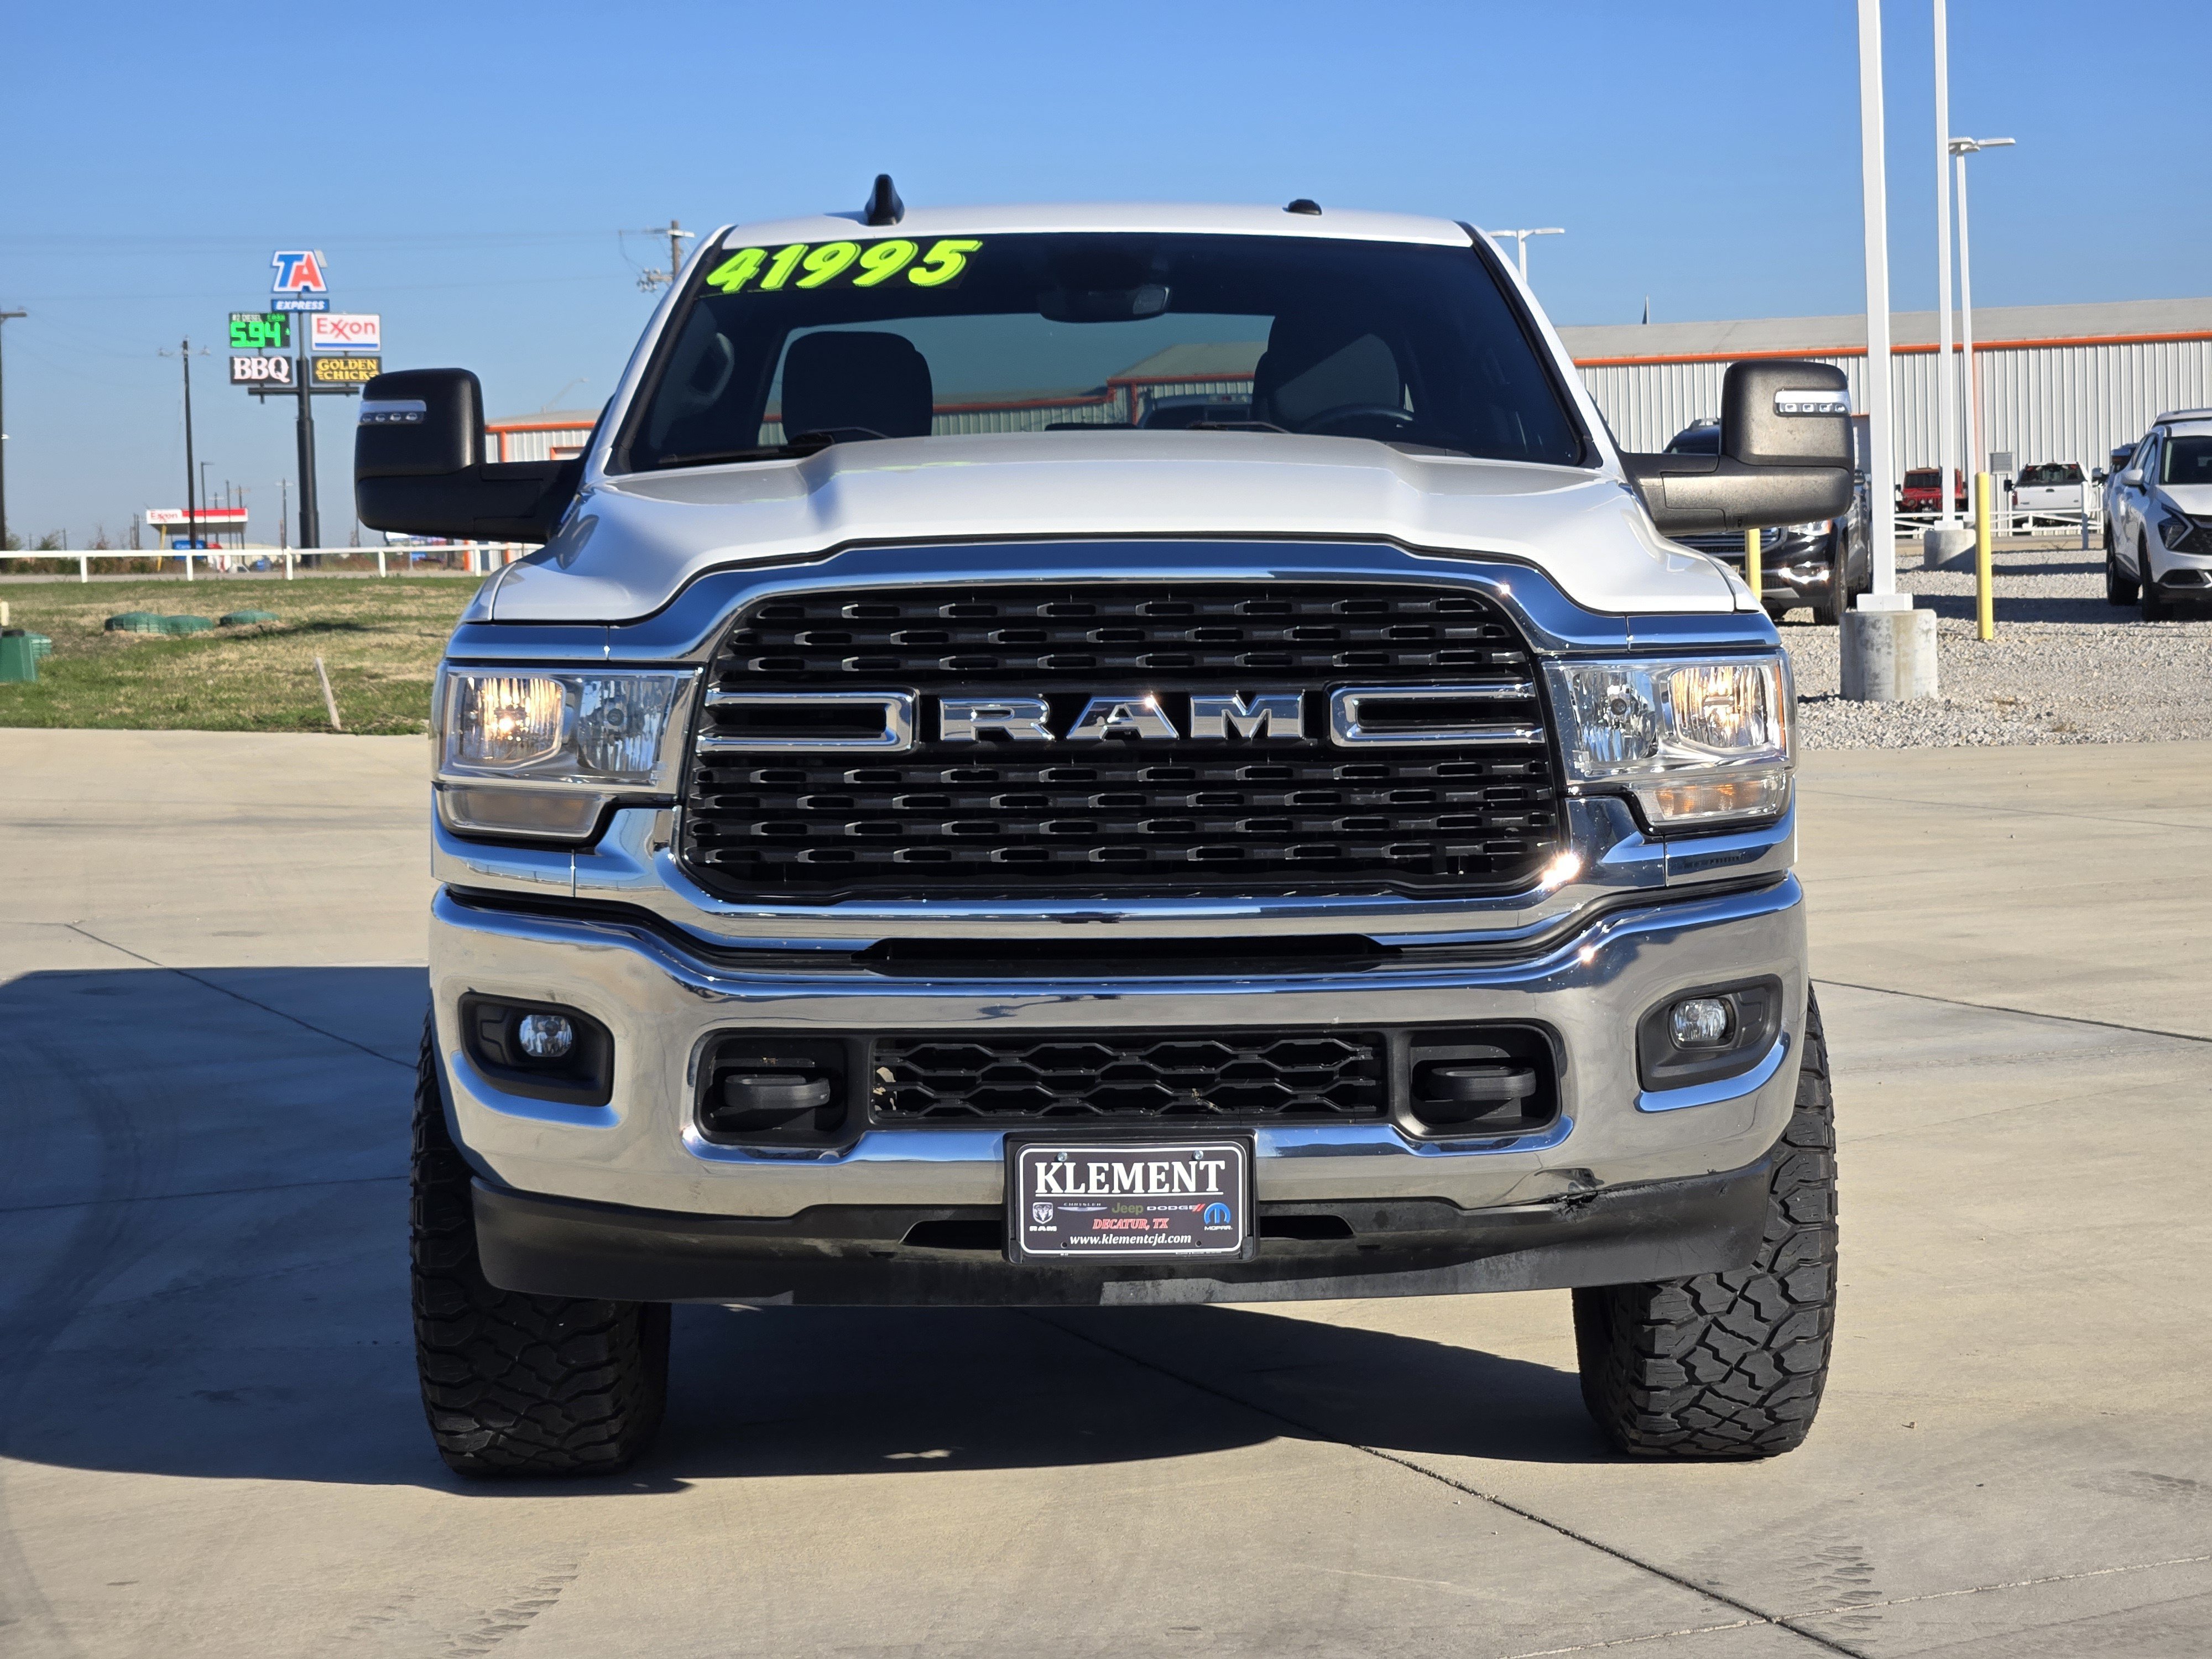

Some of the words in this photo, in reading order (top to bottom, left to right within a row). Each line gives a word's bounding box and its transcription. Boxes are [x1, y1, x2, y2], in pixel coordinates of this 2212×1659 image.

[274, 252, 325, 290] TA
[706, 239, 983, 293] 41995
[276, 300, 325, 310] EXPRESS
[316, 317, 376, 341] Exxon
[233, 356, 290, 382] BBQ
[317, 358, 378, 371] GOLDEN
[324, 371, 370, 380] CHICK
[940, 695, 1305, 739] RAM
[1035, 1160, 1225, 1194] KLEMENT
[1112, 1202, 1144, 1215] Jeep
[1092, 1218, 1150, 1230] DECATUR,
[1152, 1218, 1170, 1229] TX
[1070, 1233, 1192, 1246] www.klementcjd.com
